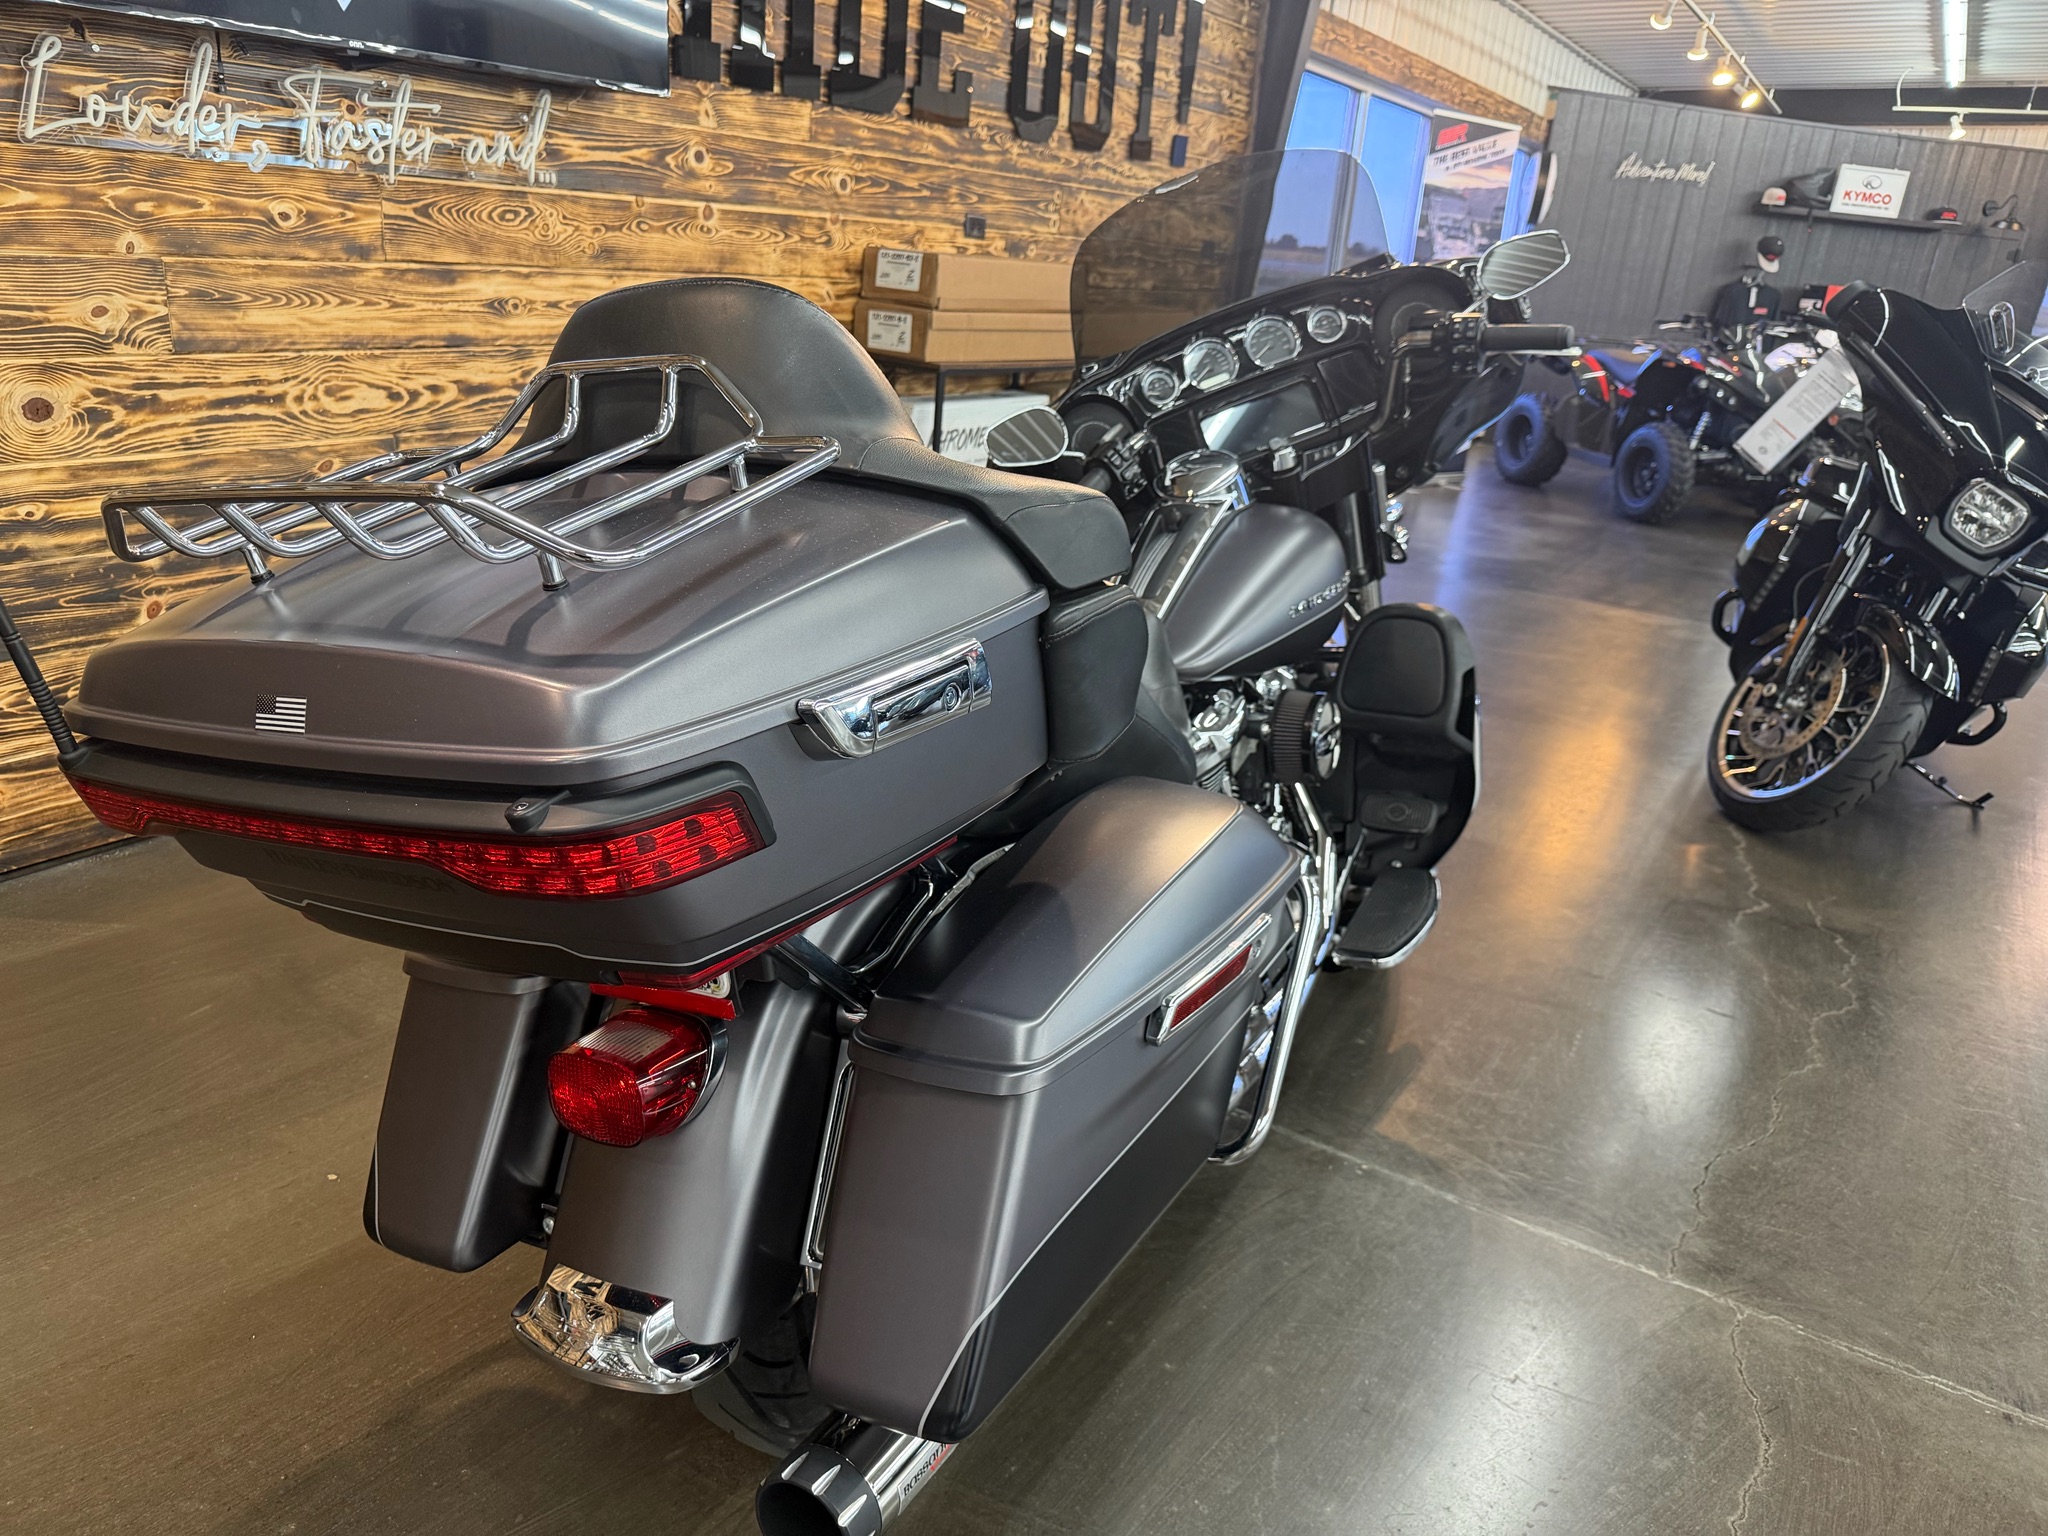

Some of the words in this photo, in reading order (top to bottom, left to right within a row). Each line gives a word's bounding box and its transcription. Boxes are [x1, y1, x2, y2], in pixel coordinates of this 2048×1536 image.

[25, 36, 268, 167] Louder,
[284, 69, 453, 184] Faster
[1842, 189, 1893, 206] KYMCO
